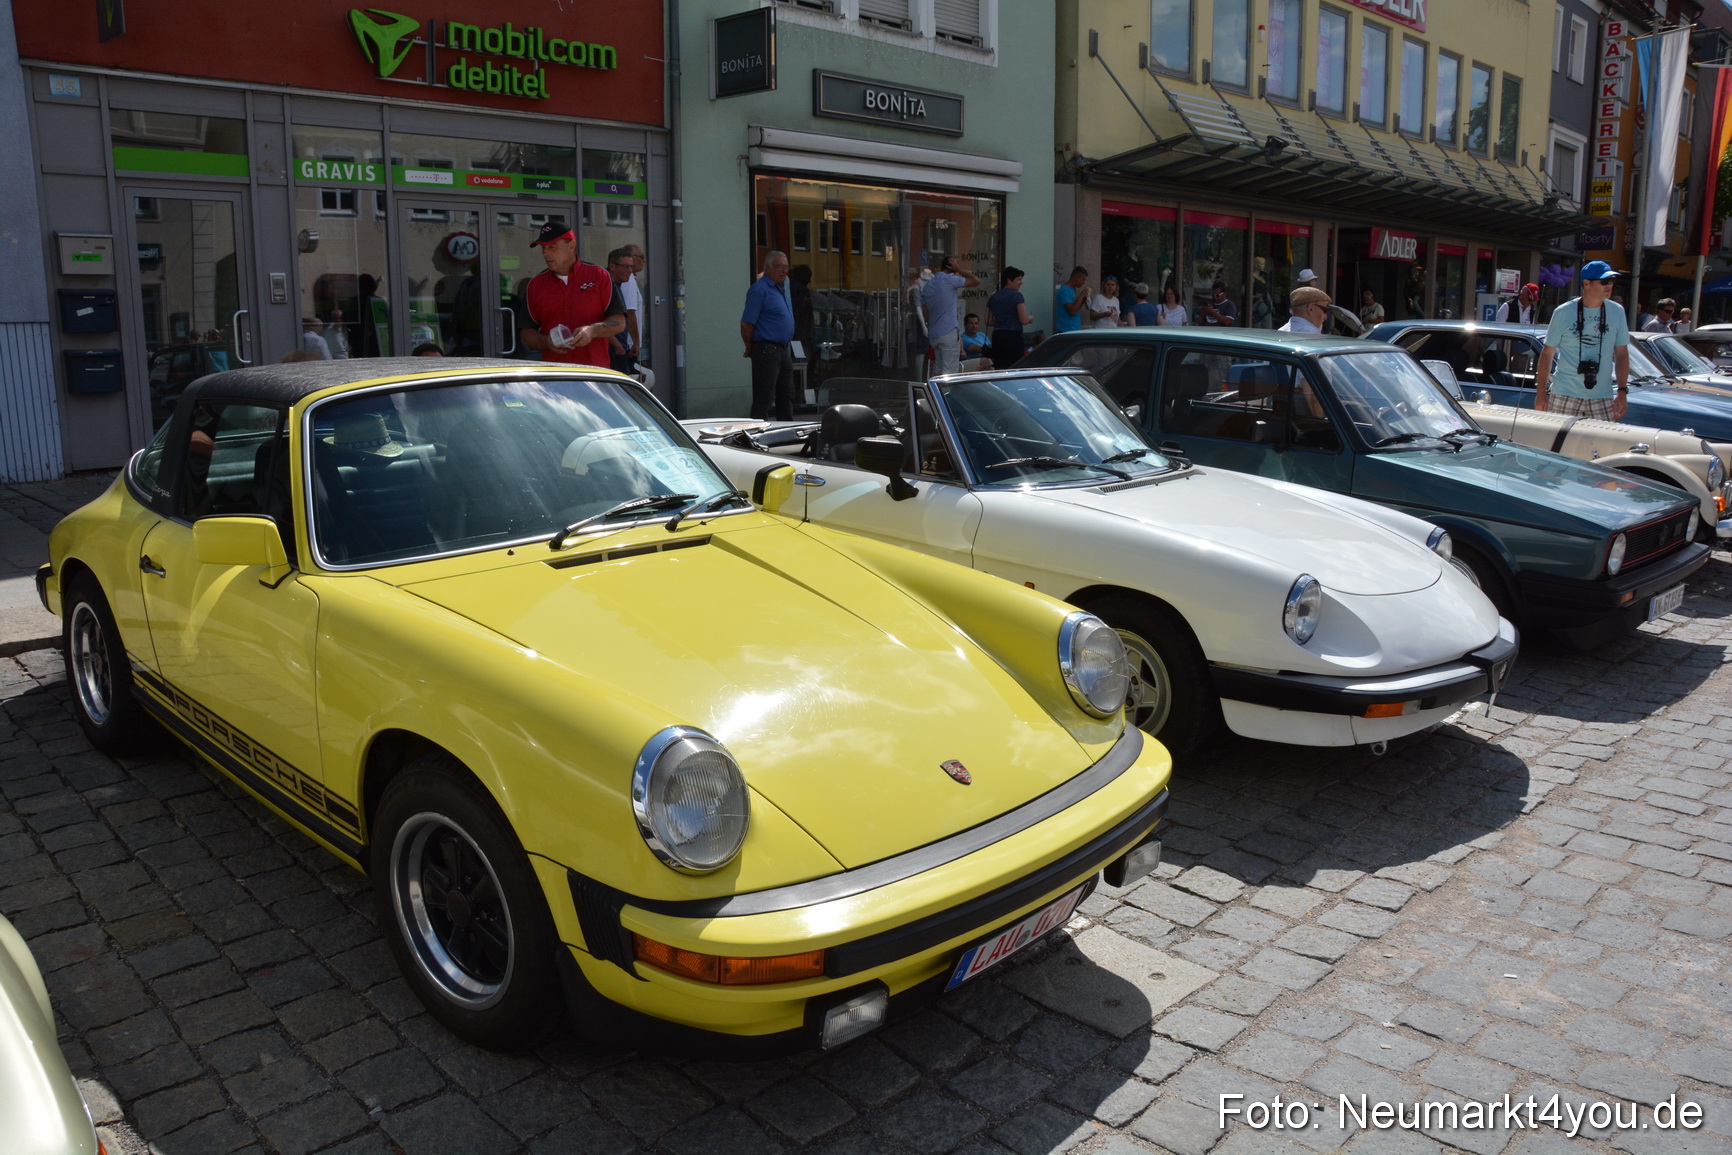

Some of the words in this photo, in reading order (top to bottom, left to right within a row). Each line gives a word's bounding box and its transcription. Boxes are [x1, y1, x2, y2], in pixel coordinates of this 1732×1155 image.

[446, 21, 617, 69] mobilcom
[53, 79, 77, 93] 45
[448, 57, 550, 99] debitel
[865, 91, 926, 119] BONITA
[1599, 22, 1623, 176] BÄCKEREI
[301, 160, 376, 182] GRAVIS
[481, 176, 504, 185] vodafone
[1592, 182, 1612, 194] café
[1380, 230, 1417, 260] ADLER
[1579, 232, 1612, 246] liberty
[1485, 307, 1494, 320] P
[175, 692, 325, 808] PORSCHE
[970, 924, 1025, 973] LAU
